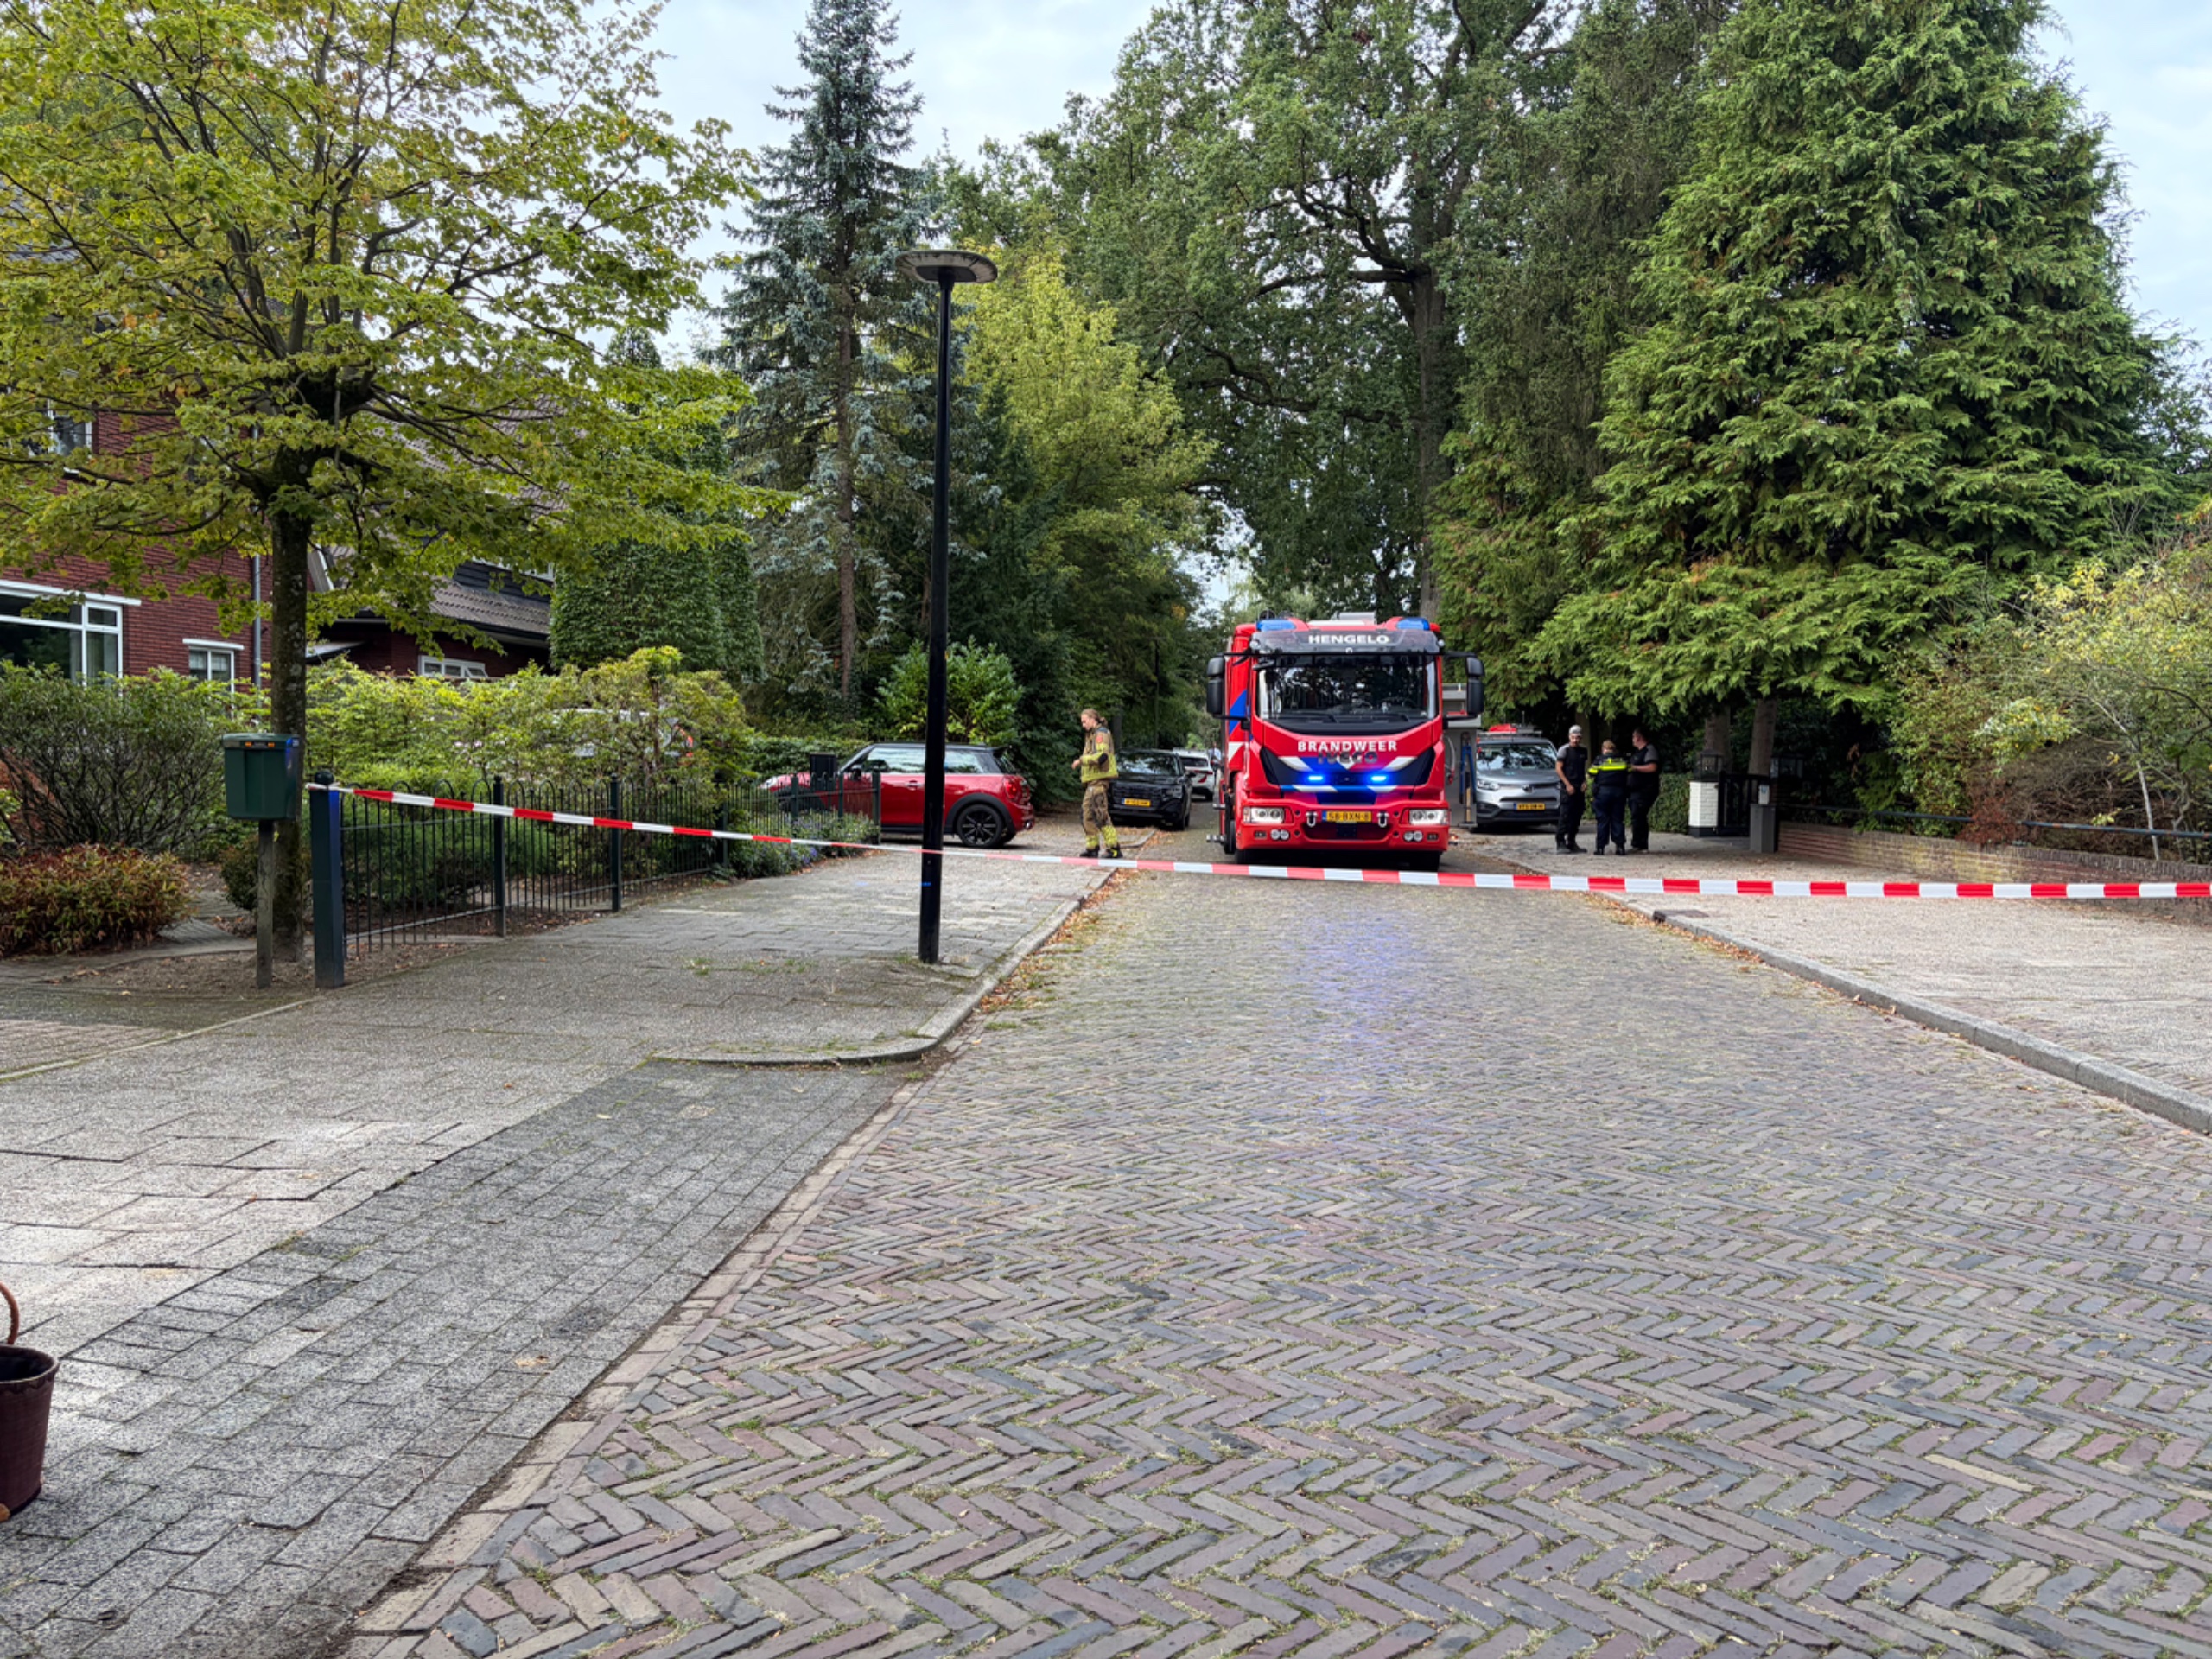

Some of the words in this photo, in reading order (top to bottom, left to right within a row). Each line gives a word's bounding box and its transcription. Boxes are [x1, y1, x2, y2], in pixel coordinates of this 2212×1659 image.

[1308, 634, 1389, 644] HENGELO
[1298, 741, 1397, 752] BRANDWEER
[1318, 751, 1378, 764] IVECO
